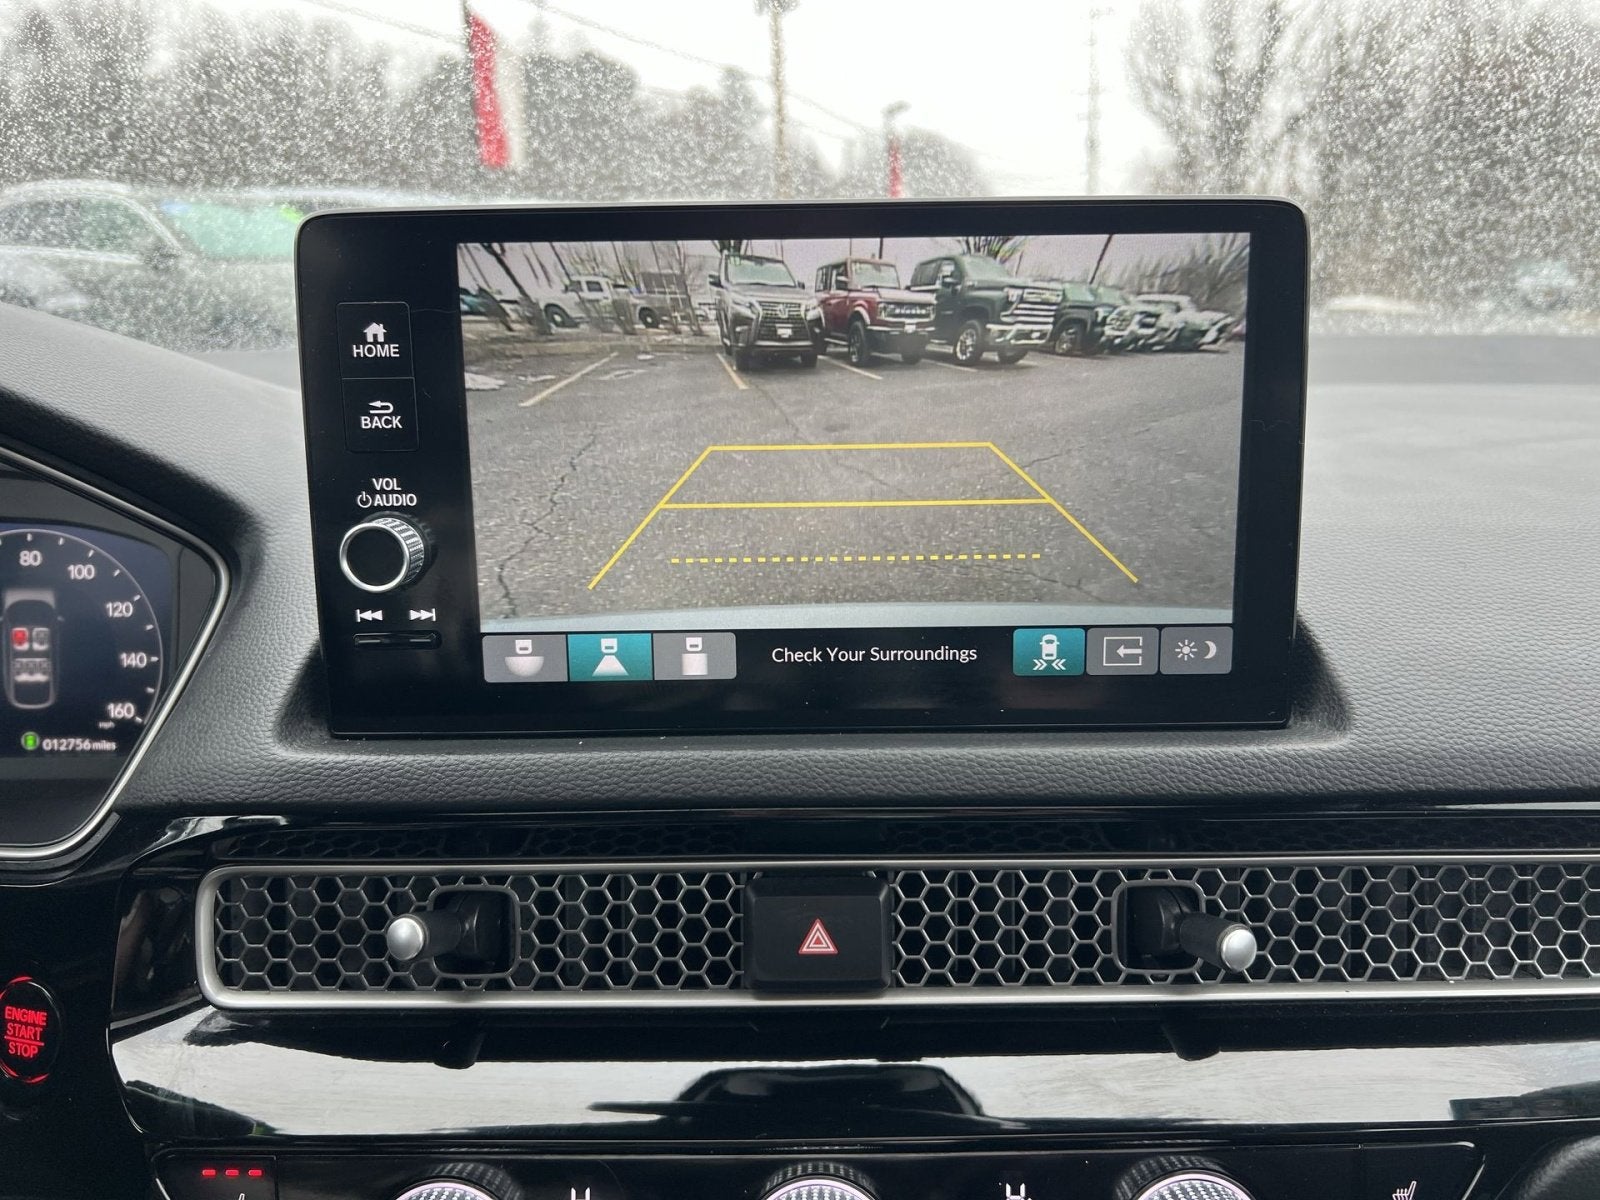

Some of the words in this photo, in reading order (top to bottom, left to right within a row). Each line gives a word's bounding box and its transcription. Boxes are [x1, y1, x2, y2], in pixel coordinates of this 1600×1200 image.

[352, 344, 400, 358] HOME
[361, 416, 402, 429] BACK
[372, 478, 402, 491] VOL
[374, 494, 417, 507] AUDIO
[19, 551, 42, 566] 80
[67, 564, 95, 580] 100
[106, 602, 133, 617] 120
[120, 652, 147, 668] 140
[771, 647, 823, 662] Check
[826, 647, 865, 662] Your
[870, 646, 977, 663] Surroundings
[107, 703, 134, 719] 160
[42, 739, 91, 751] 012756
[92, 740, 116, 751] miles
[5, 1006, 47, 1026] ENGINE
[7, 1022, 43, 1040] START
[8, 1041, 39, 1058] STOP
